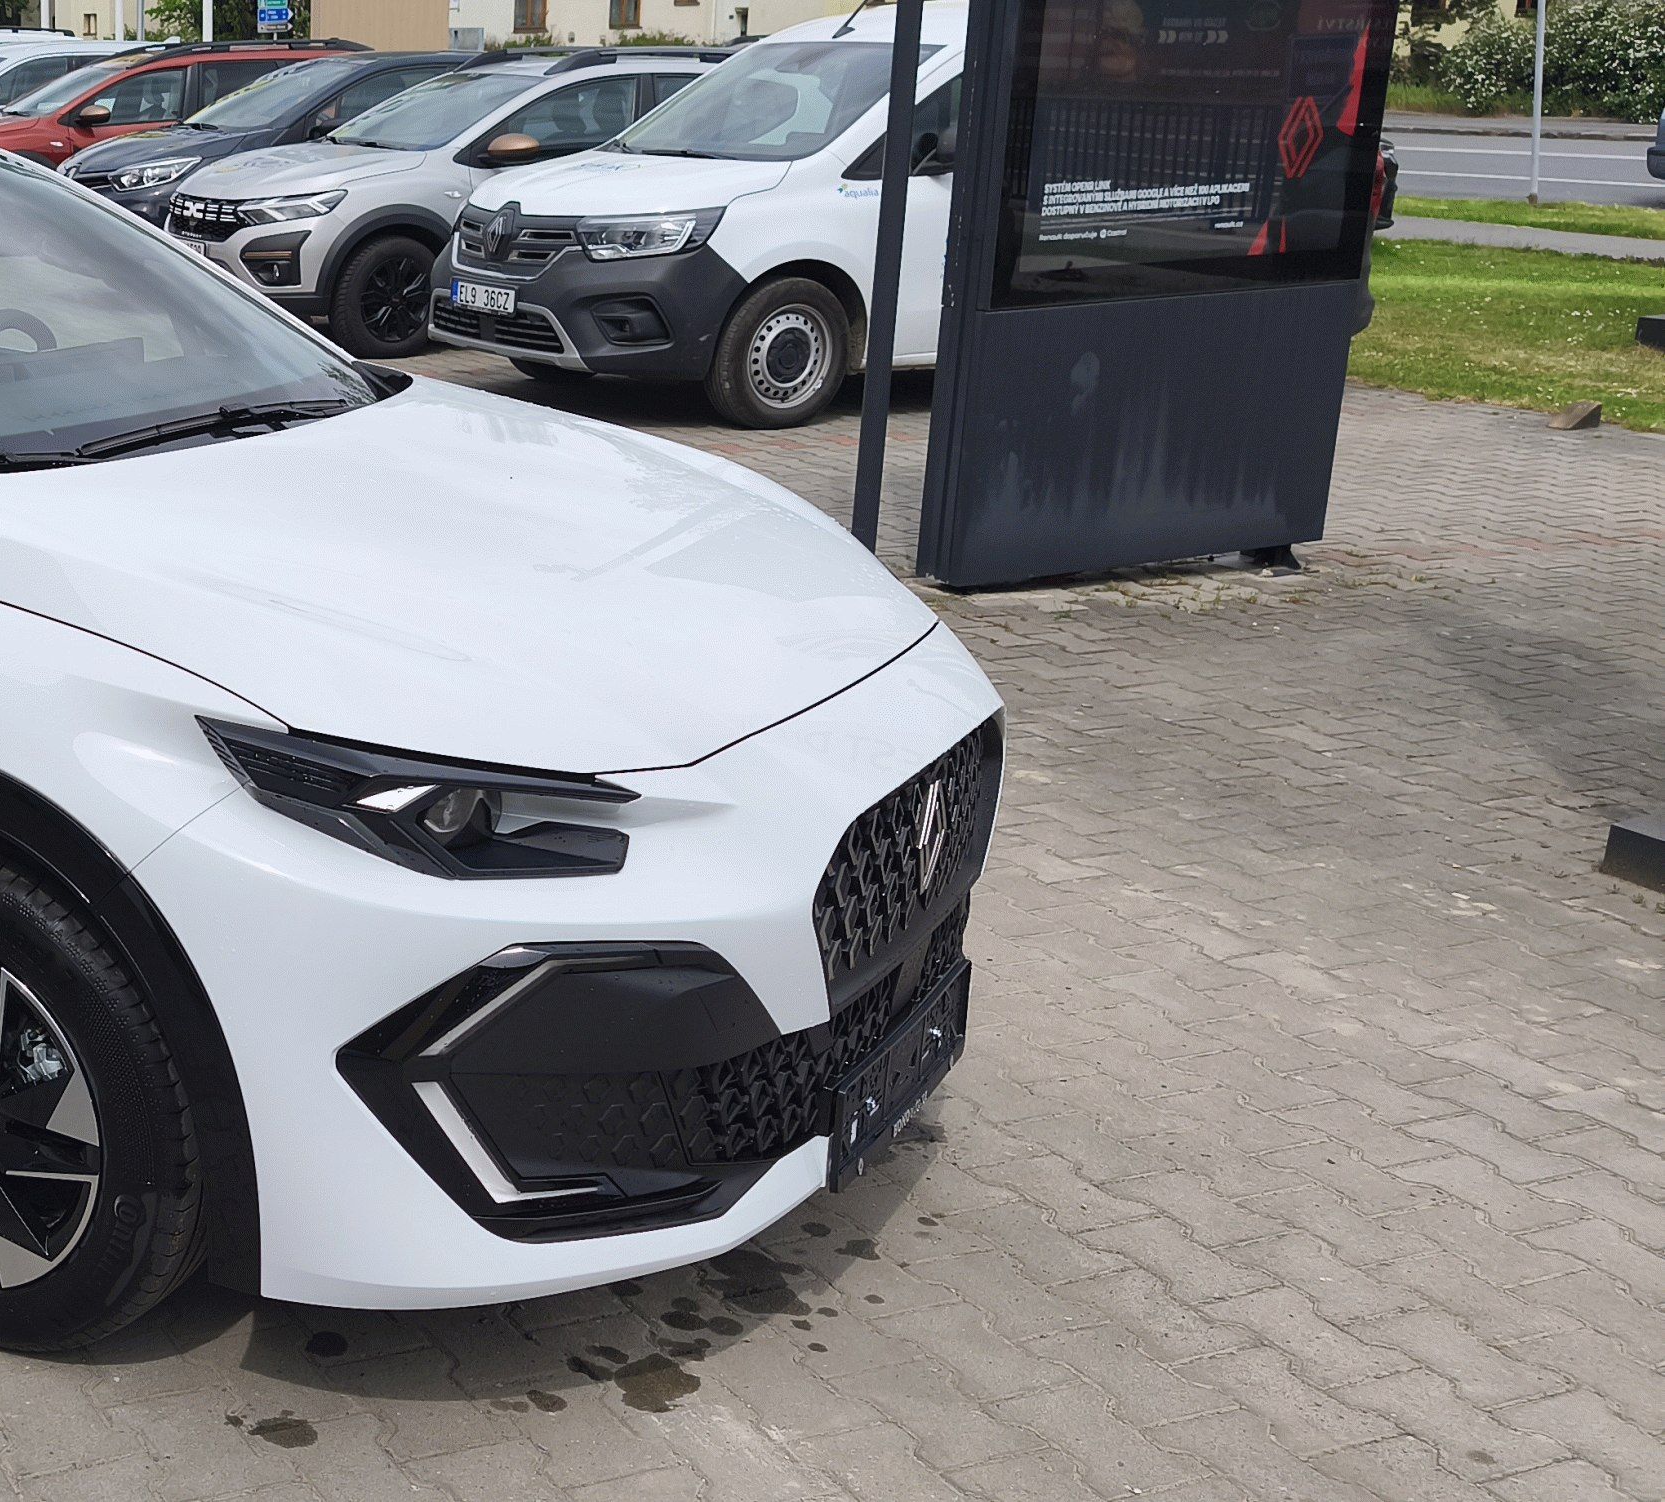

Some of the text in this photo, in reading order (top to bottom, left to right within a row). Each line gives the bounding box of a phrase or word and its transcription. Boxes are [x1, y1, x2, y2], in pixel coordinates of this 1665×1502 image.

[844, 187, 879, 199] aqualia
[1043, 195, 1048, 205] S
[1104, 188, 1137, 201] SLUŽBAMI
[1137, 187, 1163, 199] GOOGLE
[1163, 187, 1169, 197] A
[1170, 184, 1185, 196] VÍCE
[1185, 183, 1197, 196] NEŽ
[1198, 185, 1209, 195] 100
[1209, 183, 1250, 194] APLIKACEMI
[1044, 180, 1072, 194] SYSTÉM
[1095, 180, 1111, 190] LINK
[1041, 202, 1079, 216] DOSTUPNÝ
[1079, 204, 1085, 214] V
[1122, 201, 1127, 211] A
[1128, 197, 1159, 210] HYBRIDNÍ
[1038, 233, 1062, 241] Renault
[1063, 231, 1097, 240] doporučuje
[459, 284, 510, 311] EL9 36CZ
